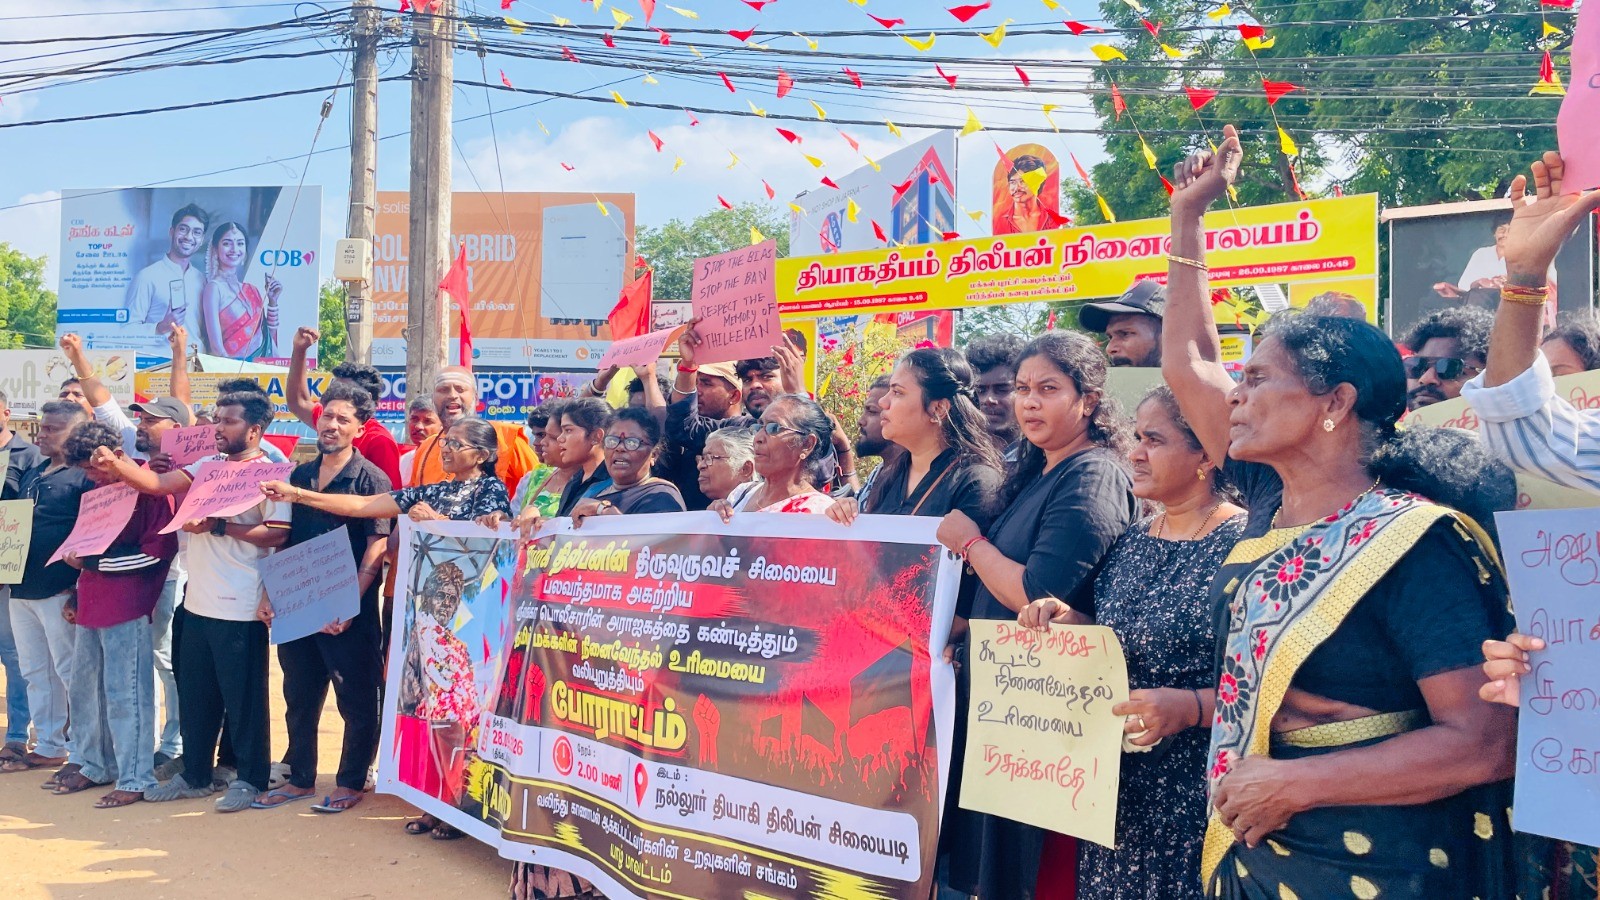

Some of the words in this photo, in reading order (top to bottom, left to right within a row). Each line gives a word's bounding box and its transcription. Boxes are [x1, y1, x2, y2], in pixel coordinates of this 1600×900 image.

[260, 250, 302, 267] CDB
[451, 234, 516, 262] YBRID
[797, 250, 940, 292] தியாகதீபம்
[948, 238, 1054, 278] திலீபன்
[1062, 211, 1319, 268] நினைாலயம்
[700, 260, 725, 281] STOP
[728, 256, 744, 268] THE
[747, 249, 773, 263] BIAS
[1238, 265, 1288, 275] 26.09.1987
[1322, 260, 1349, 269] 10.48
[700, 284, 722, 299] STOP
[724, 279, 739, 289] THE
[743, 268, 767, 286] BAN
[701, 300, 736, 319] RESPECT
[743, 293, 766, 304] THE
[723, 310, 757, 328] MEMORY
[762, 303, 776, 316] OF
[371, 345, 394, 355] solis
[705, 319, 770, 350] THILEEPAN
[478, 378, 534, 400] POT
[204, 468, 251, 482] SHAME
[254, 468, 273, 477] ON
[274, 465, 293, 473] THE
[189, 498, 216, 506] STOP
[217, 495, 239, 503] THE
[549, 540, 631, 576] திலீபனின்
[635, 546, 740, 582] திருவுருவச்
[748, 556, 836, 586] சிலையை
[543, 575, 622, 603] பலவந்தமாக
[627, 581, 693, 612] அகற்றிய
[607, 614, 690, 645] அராஜகத்தை
[697, 621, 797, 659] கண்டித்தும்
[533, 629, 578, 654] மக்களின்
[581, 635, 662, 671] நினைவேந்தல்
[668, 650, 766, 684] உரிமையை
[572, 661, 645, 695] வலியுறுத்தியும்
[995, 664, 1113, 715] நினைவேந்தல்
[551, 680, 687, 750] போராட்டம்
[978, 701, 1083, 737] உரிமையை
[577, 762, 598, 782] 2.00
[601, 771, 622, 793] மணி
[656, 767, 681, 781] இடம்
[655, 784, 706, 817] நல்லூர்
[713, 794, 760, 826] தியாகி
[767, 806, 821, 841] திலீபன்
[828, 822, 909, 864] சிலையடி
[537, 792, 569, 817] வலிந்து
[571, 801, 601, 826] காணாமல்
[601, 812, 678, 859] ஆக்கப்பட்டவர்களின்
[684, 848, 752, 878] உறவுகளின்
[756, 863, 798, 889] சங்கம்
[625, 856, 672, 884] மாவட்டம்
